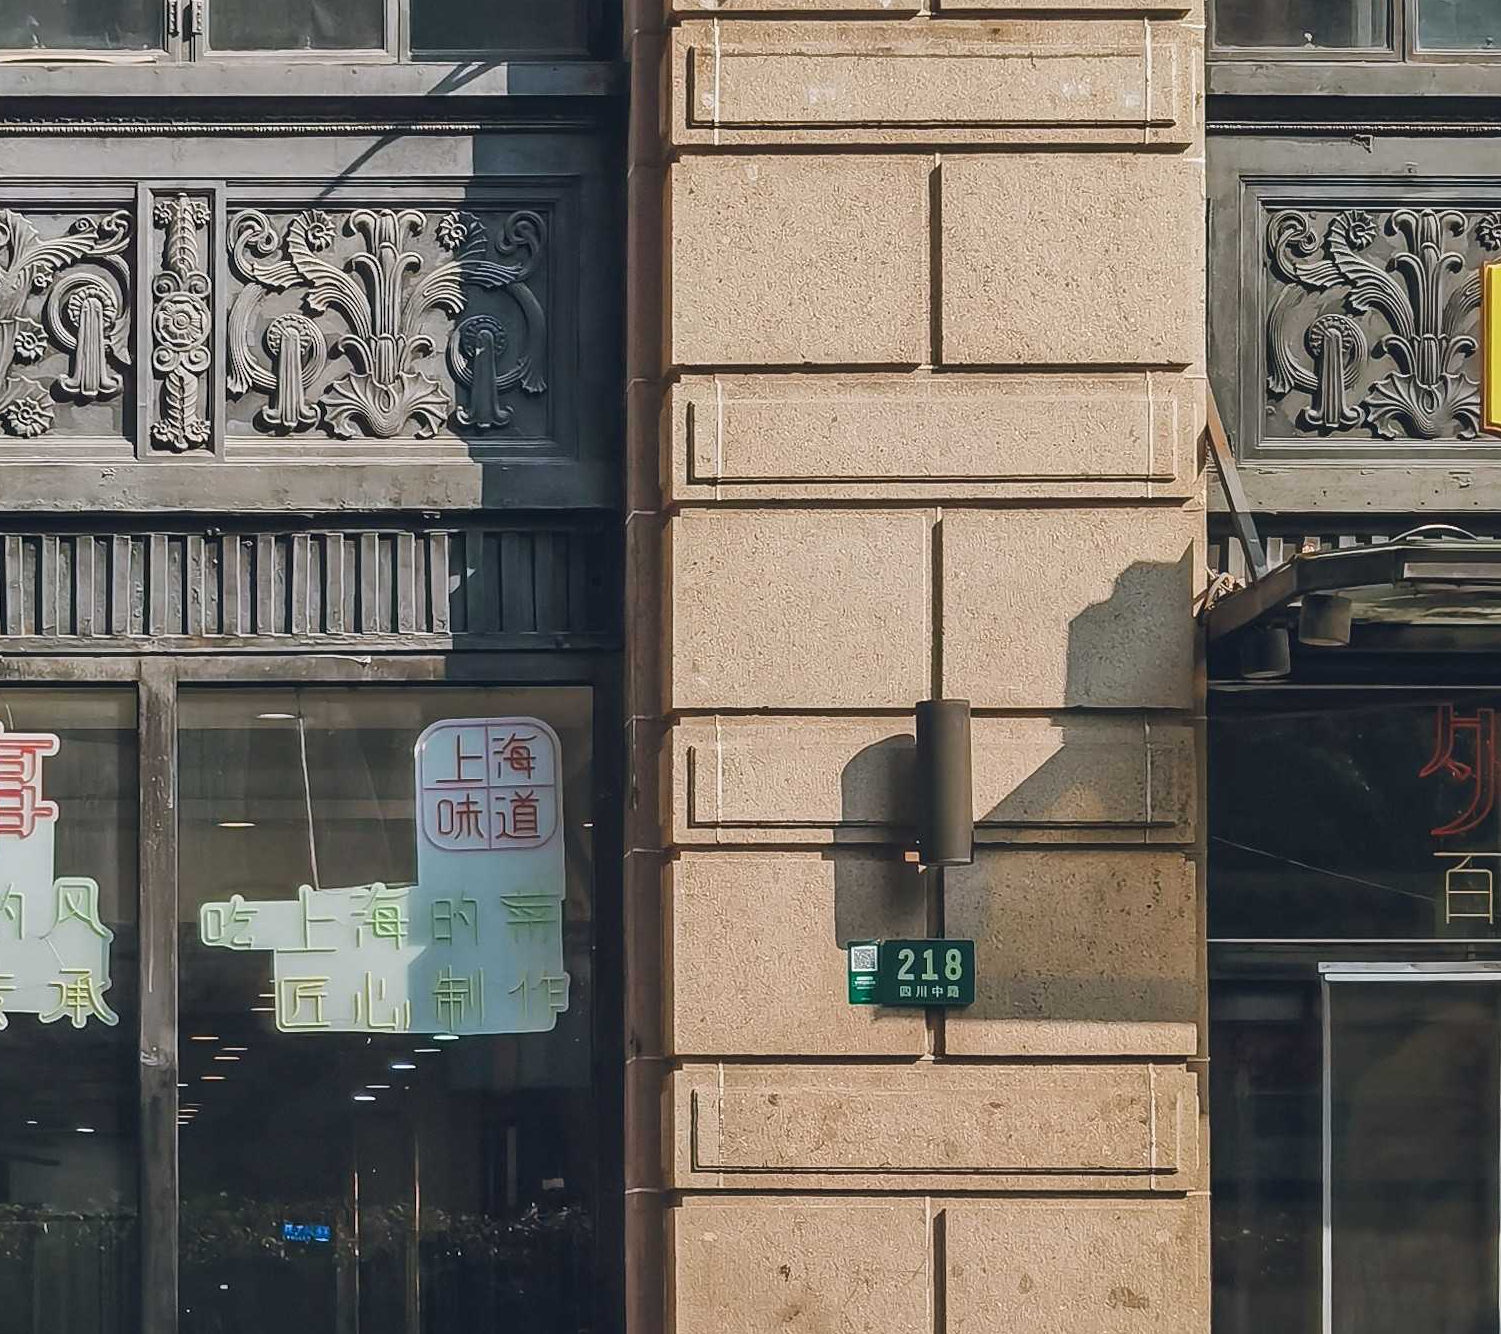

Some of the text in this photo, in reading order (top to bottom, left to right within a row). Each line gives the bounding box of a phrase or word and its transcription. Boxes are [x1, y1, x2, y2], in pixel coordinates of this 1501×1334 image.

[435, 732, 538, 785] 上海
[436, 788, 541, 841] 味道
[200, 882, 564, 954] 吃上海的菜
[897, 948, 963, 982] 218
[276, 965, 570, 1034] 匠心制作
